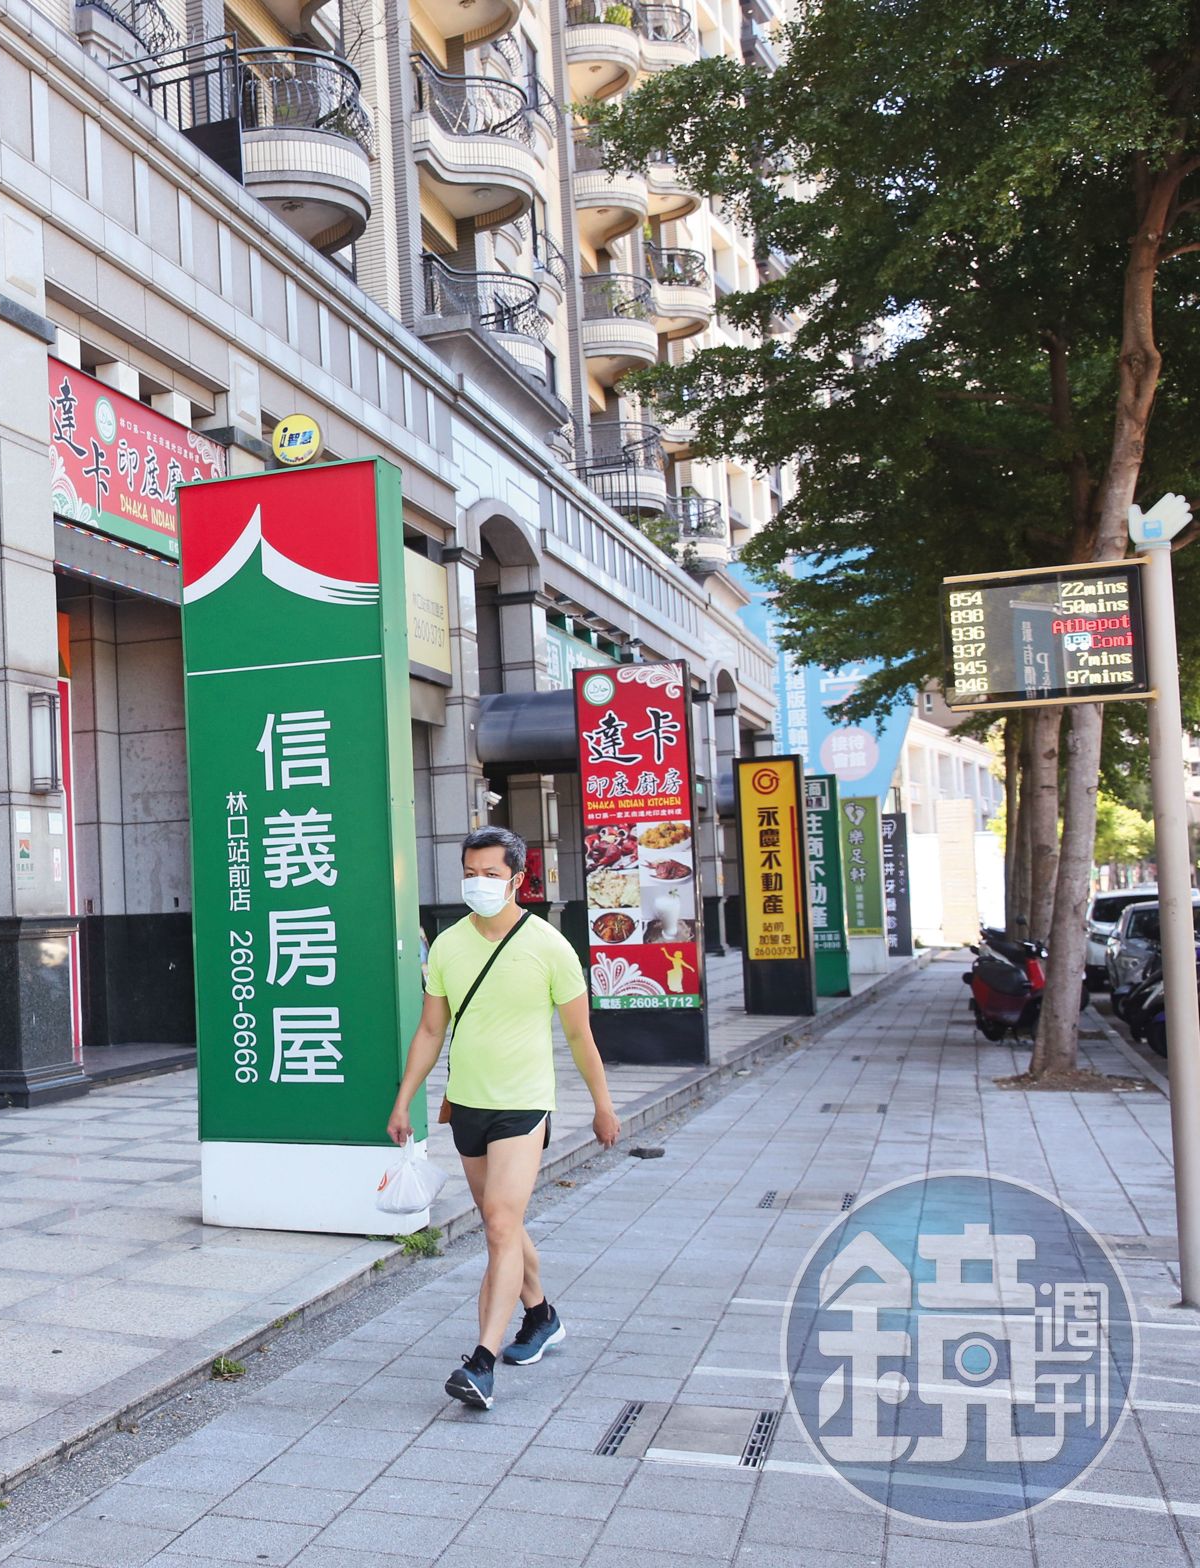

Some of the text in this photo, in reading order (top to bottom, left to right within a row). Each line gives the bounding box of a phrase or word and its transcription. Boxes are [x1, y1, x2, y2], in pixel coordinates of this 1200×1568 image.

[49, 376, 111, 515] 達卡
[119, 493, 148, 522] DHAKA
[950, 581, 1128, 607] 854 22mins
[951, 599, 1129, 625] 898 50mins
[952, 614, 1131, 641] 936 AtDepot
[953, 632, 1134, 659] 937 Comi
[953, 652, 1132, 676] 945 7mins
[955, 669, 1134, 694] 946 97mins
[583, 707, 680, 765] 達卡
[587, 797, 681, 810] DHAKA INDIAN KITCHEN
[757, 807, 784, 914] 永慶不動產
[848, 829, 867, 883] 樂足軒
[256, 709, 344, 1084] 信義房屋
[226, 791, 258, 1084] 林口站前店 2608-6666
[759, 934, 791, 945] 加盟店
[763, 922, 784, 931] 站前
